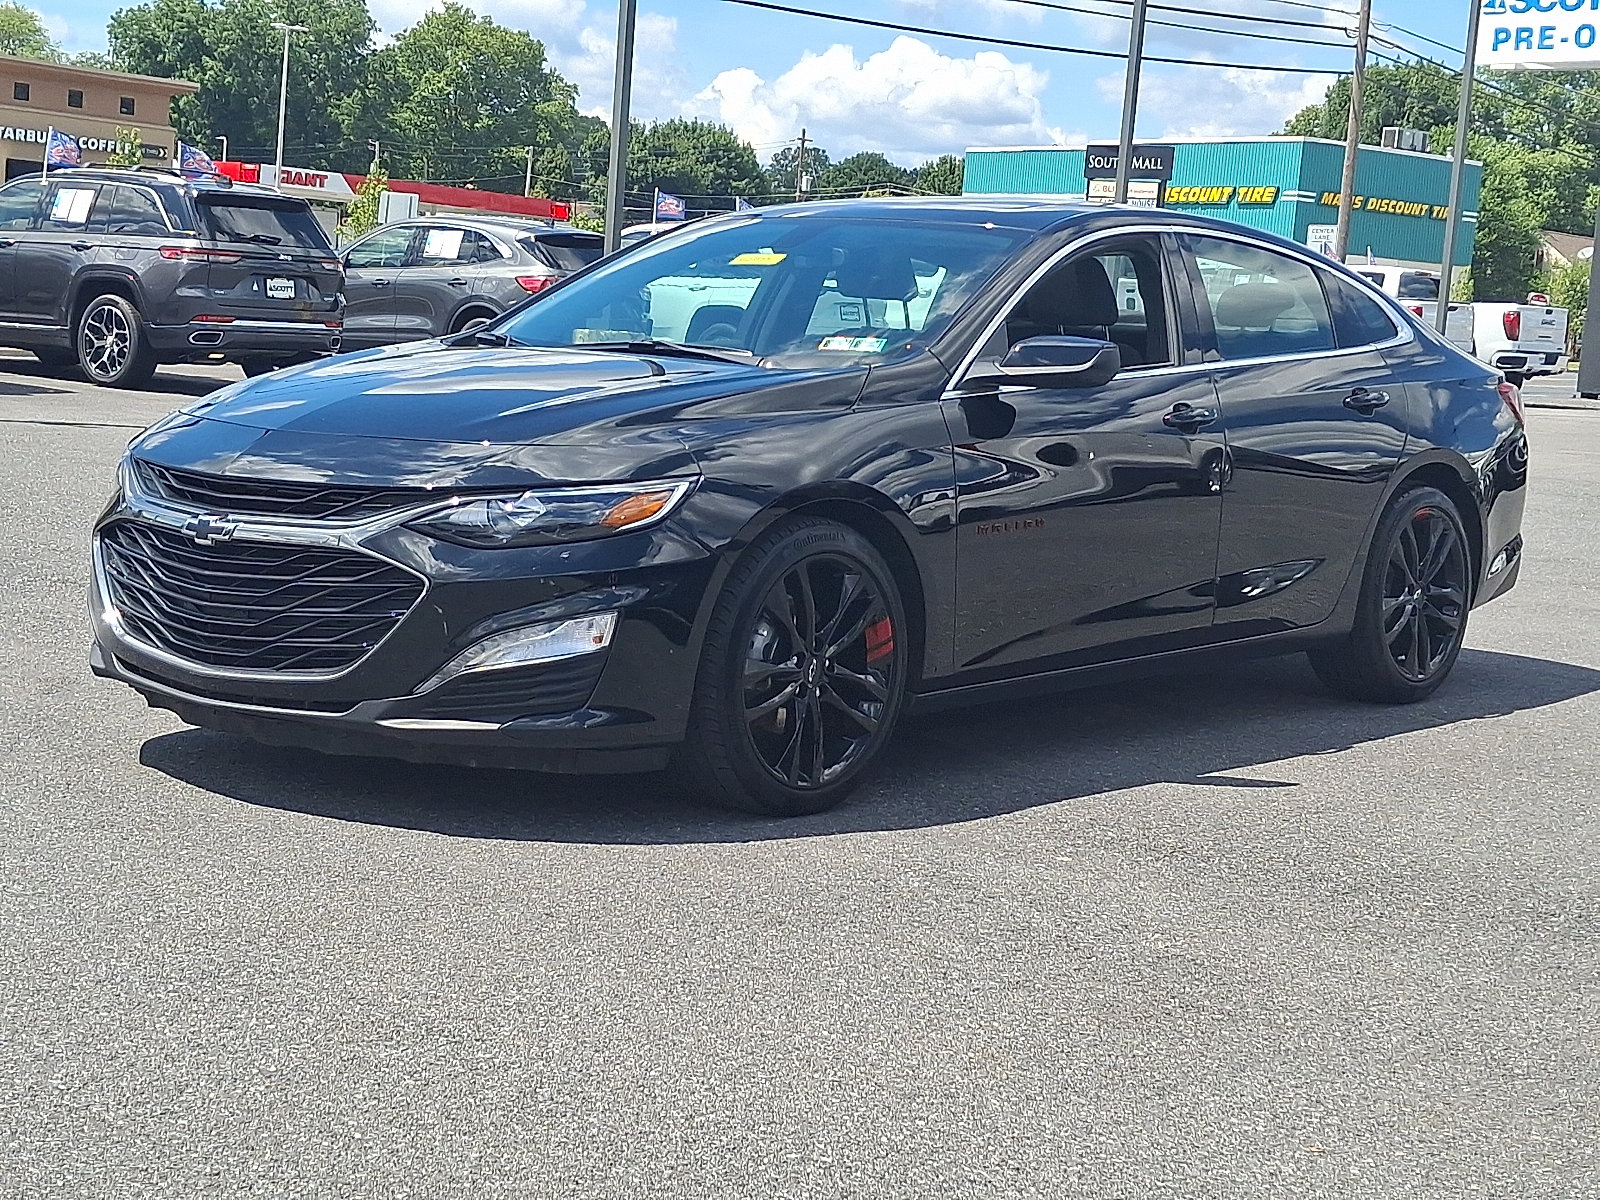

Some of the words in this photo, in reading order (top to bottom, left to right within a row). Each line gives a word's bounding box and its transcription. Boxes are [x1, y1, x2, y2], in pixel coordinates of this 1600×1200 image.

[1088, 155, 1123, 169] SOUT
[1131, 156, 1163, 170] MALL
[1165, 186, 1235, 204] ISCOUNT
[1237, 187, 1277, 204] TIRE
[1321, 192, 1363, 209] MAS
[1367, 197, 1429, 216] DISCOUNT
